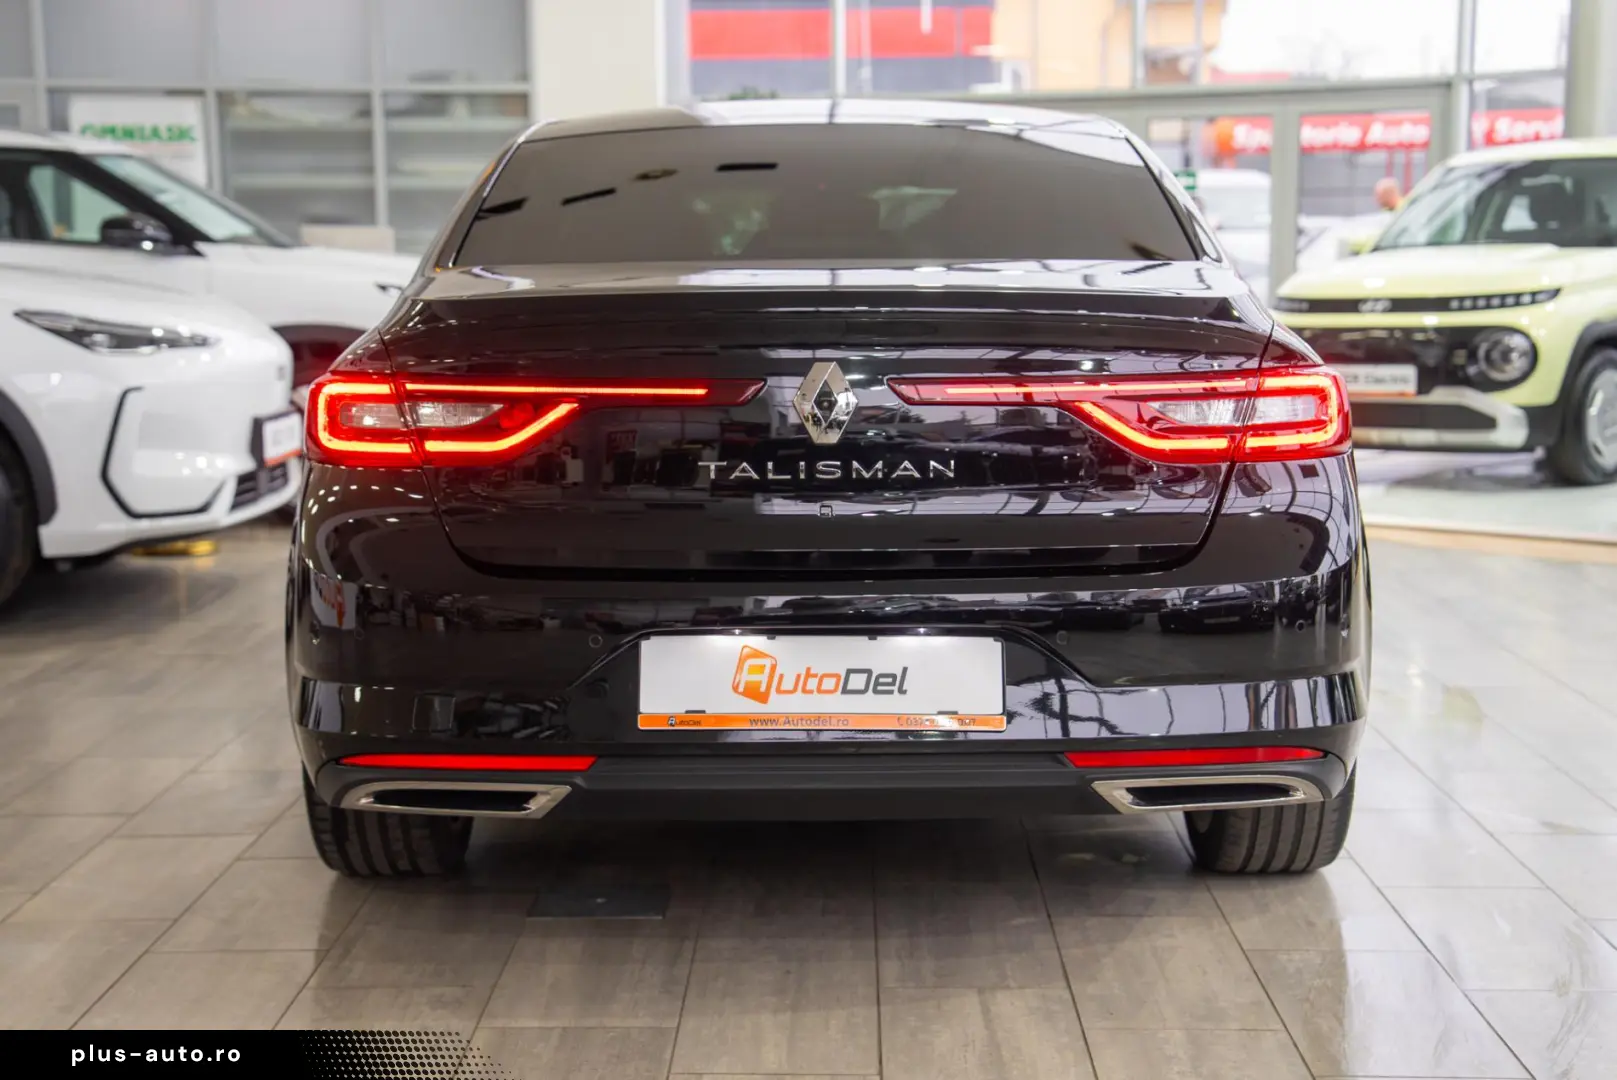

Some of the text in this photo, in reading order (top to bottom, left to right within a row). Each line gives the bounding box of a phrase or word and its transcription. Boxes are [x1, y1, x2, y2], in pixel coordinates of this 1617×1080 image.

[697, 460, 955, 480] TALISMAN
[735, 652, 908, 697] AutoDel
[749, 716, 849, 727] www.Autodel.ro
